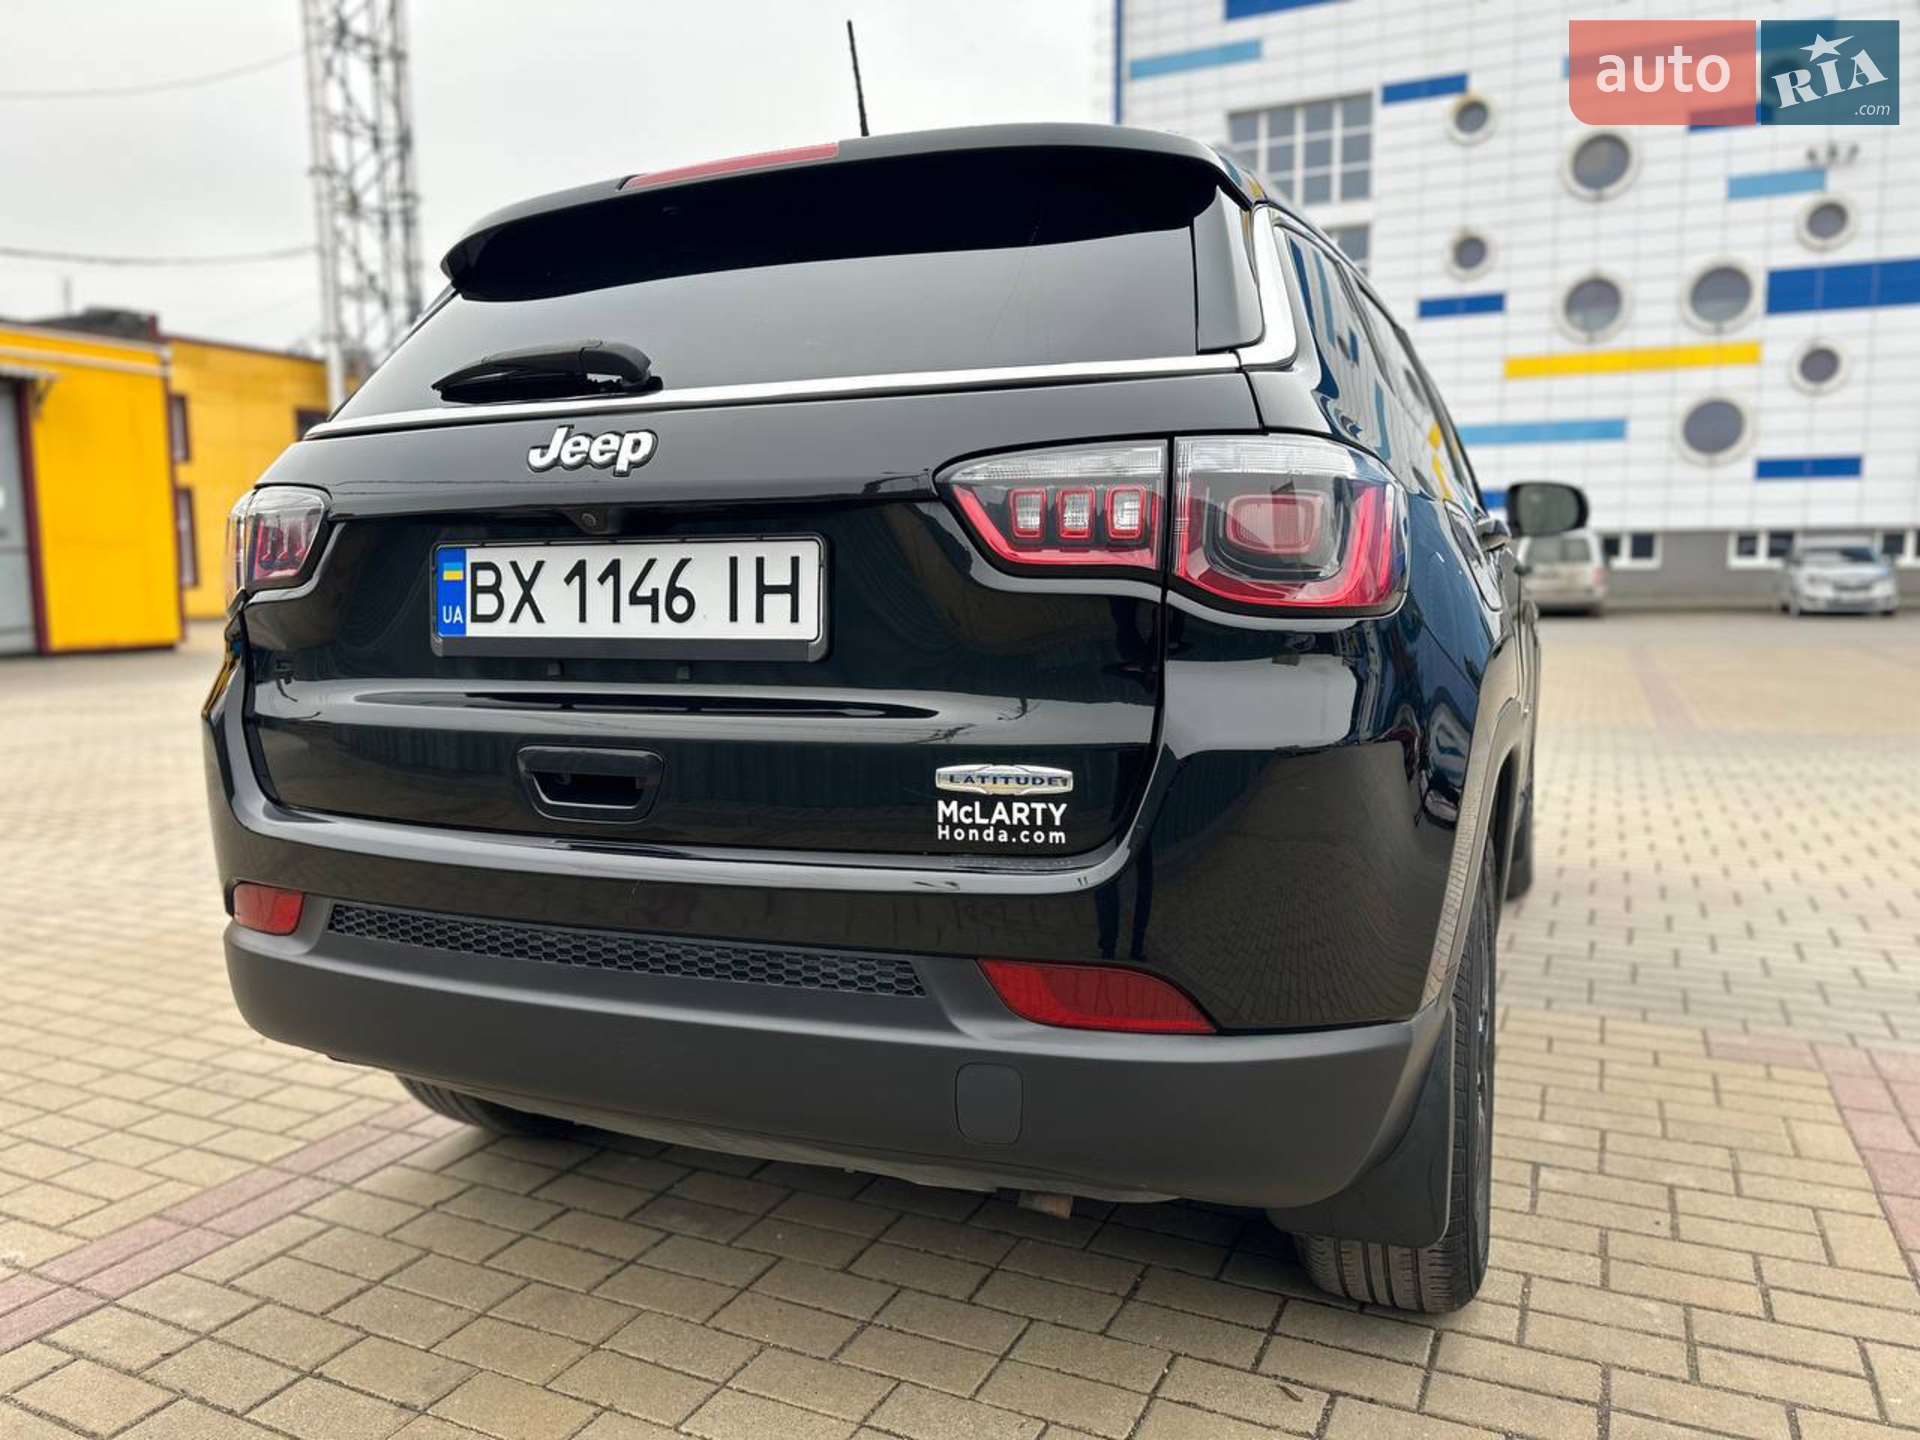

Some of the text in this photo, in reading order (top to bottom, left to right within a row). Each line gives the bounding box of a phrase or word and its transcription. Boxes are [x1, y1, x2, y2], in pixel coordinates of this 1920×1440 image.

[528, 425, 658, 477] Jeep
[469, 555, 801, 624] BX 1146 IH
[442, 603, 464, 625] UA
[949, 774, 1059, 787] LATITUDE
[937, 799, 1068, 826] McLARTY
[937, 825, 1066, 844] Honda.com
